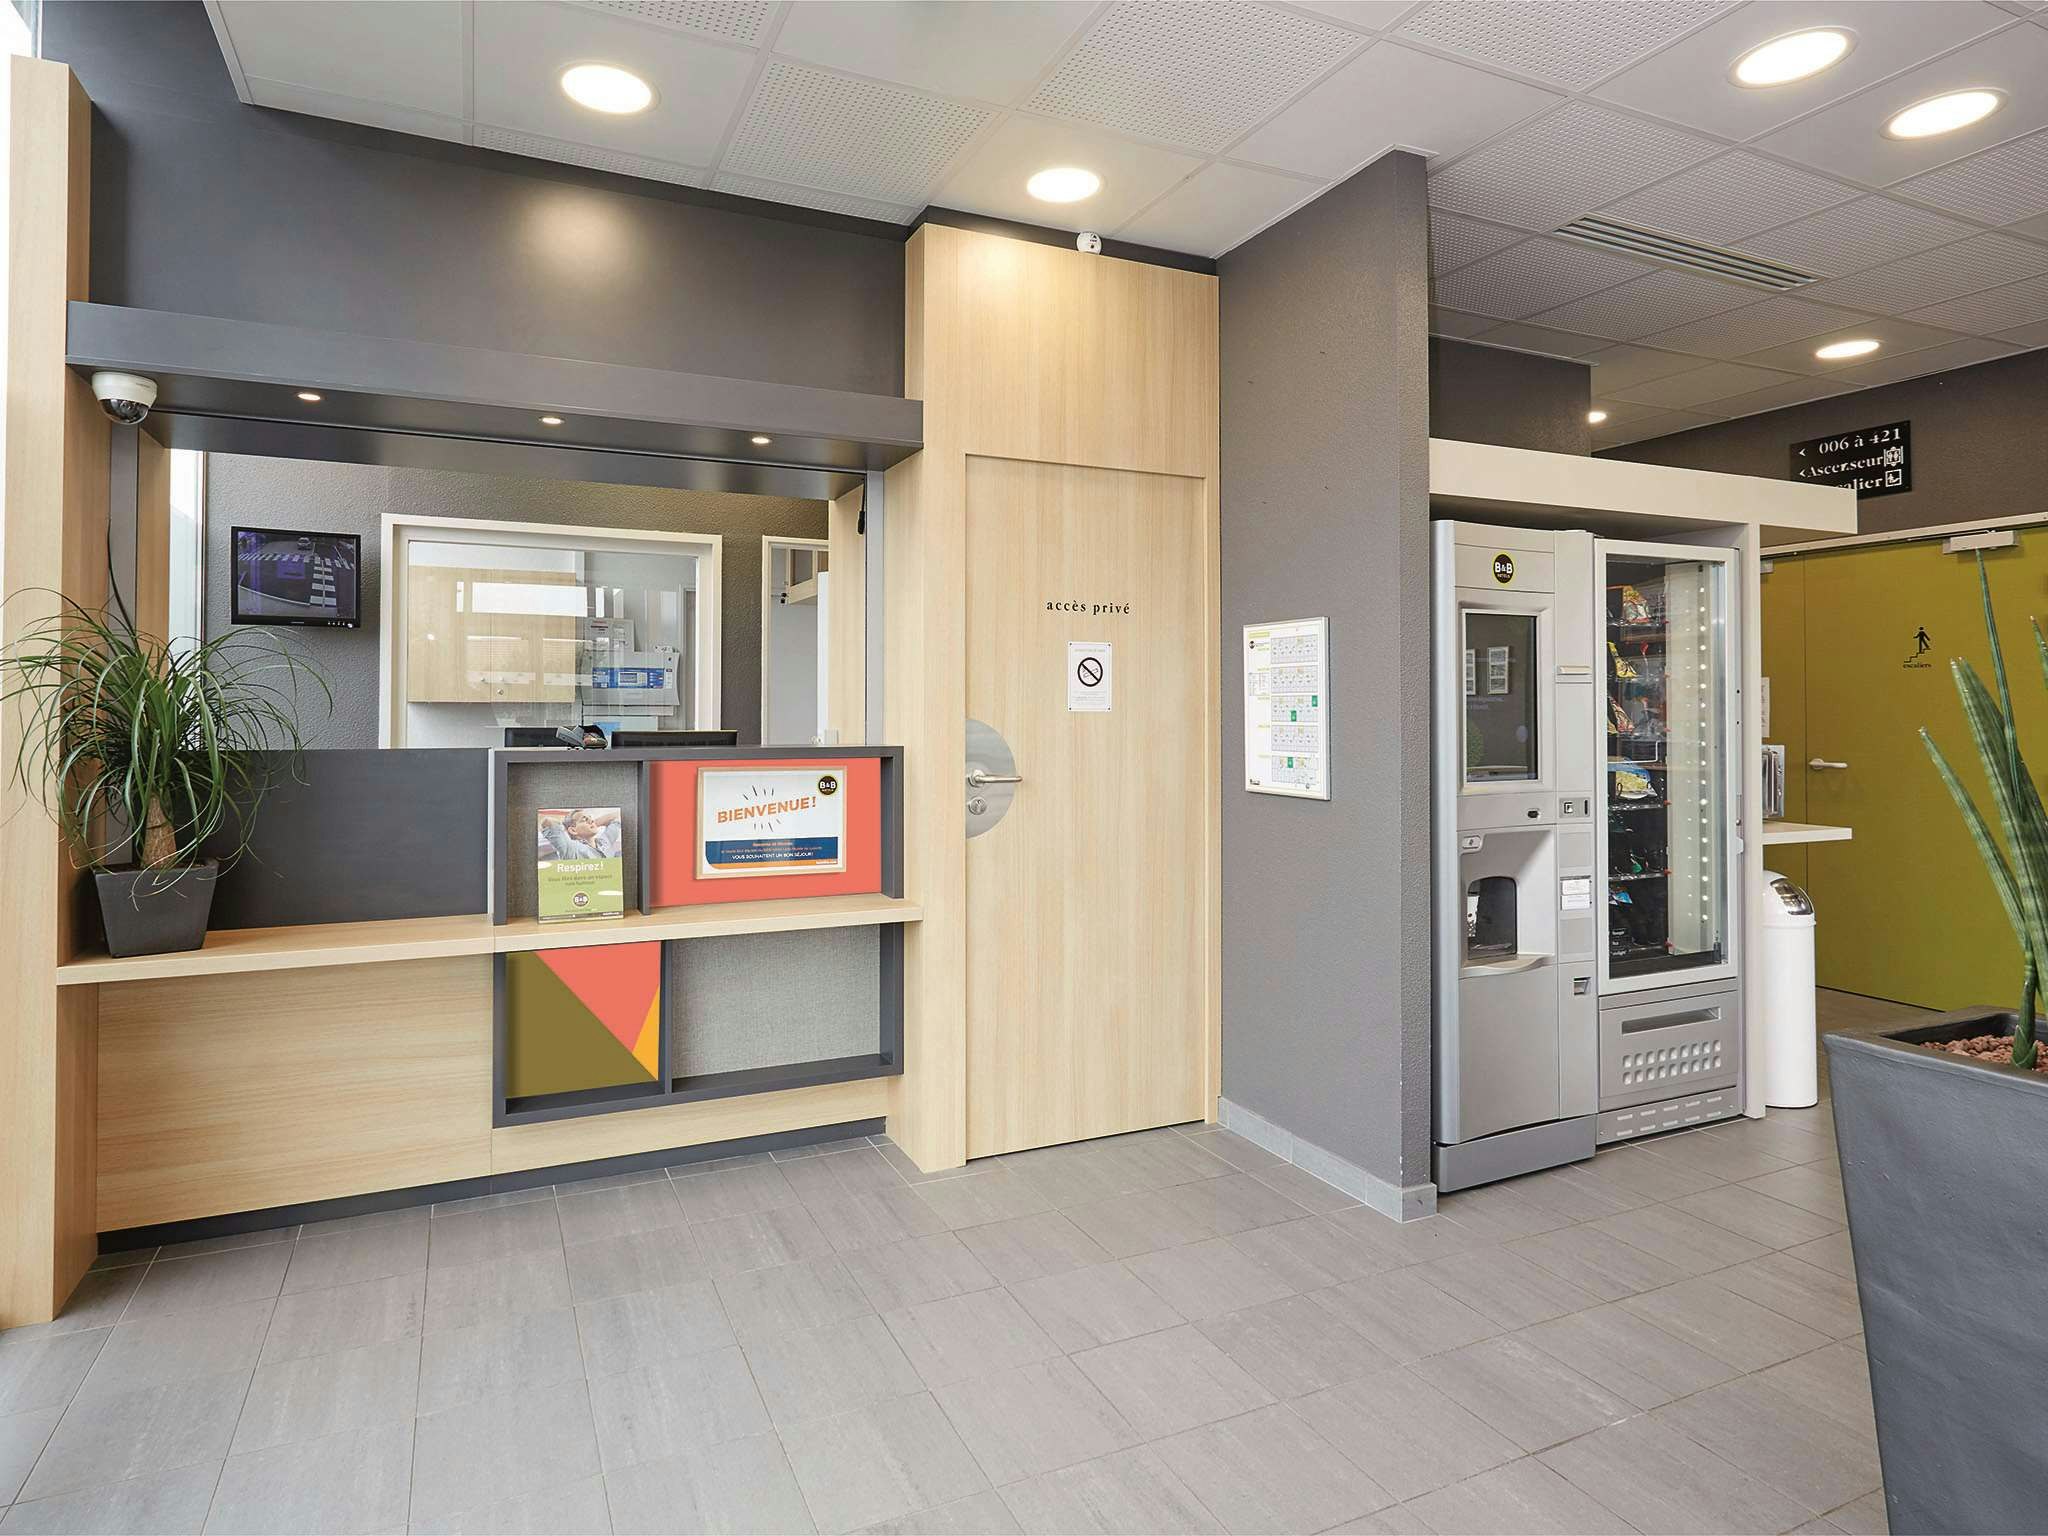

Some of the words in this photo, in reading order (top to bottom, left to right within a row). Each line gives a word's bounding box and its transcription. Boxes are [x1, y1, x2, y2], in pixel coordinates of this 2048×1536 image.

[1819, 436, 1850, 455] 006
[1854, 435, 1865, 448] à
[1869, 428, 1901, 444] 421
[1494, 562, 1513, 573] B&B
[1046, 600, 1087, 612] accès
[1093, 603, 1130, 615] privé
[819, 781, 836, 789] B&B
